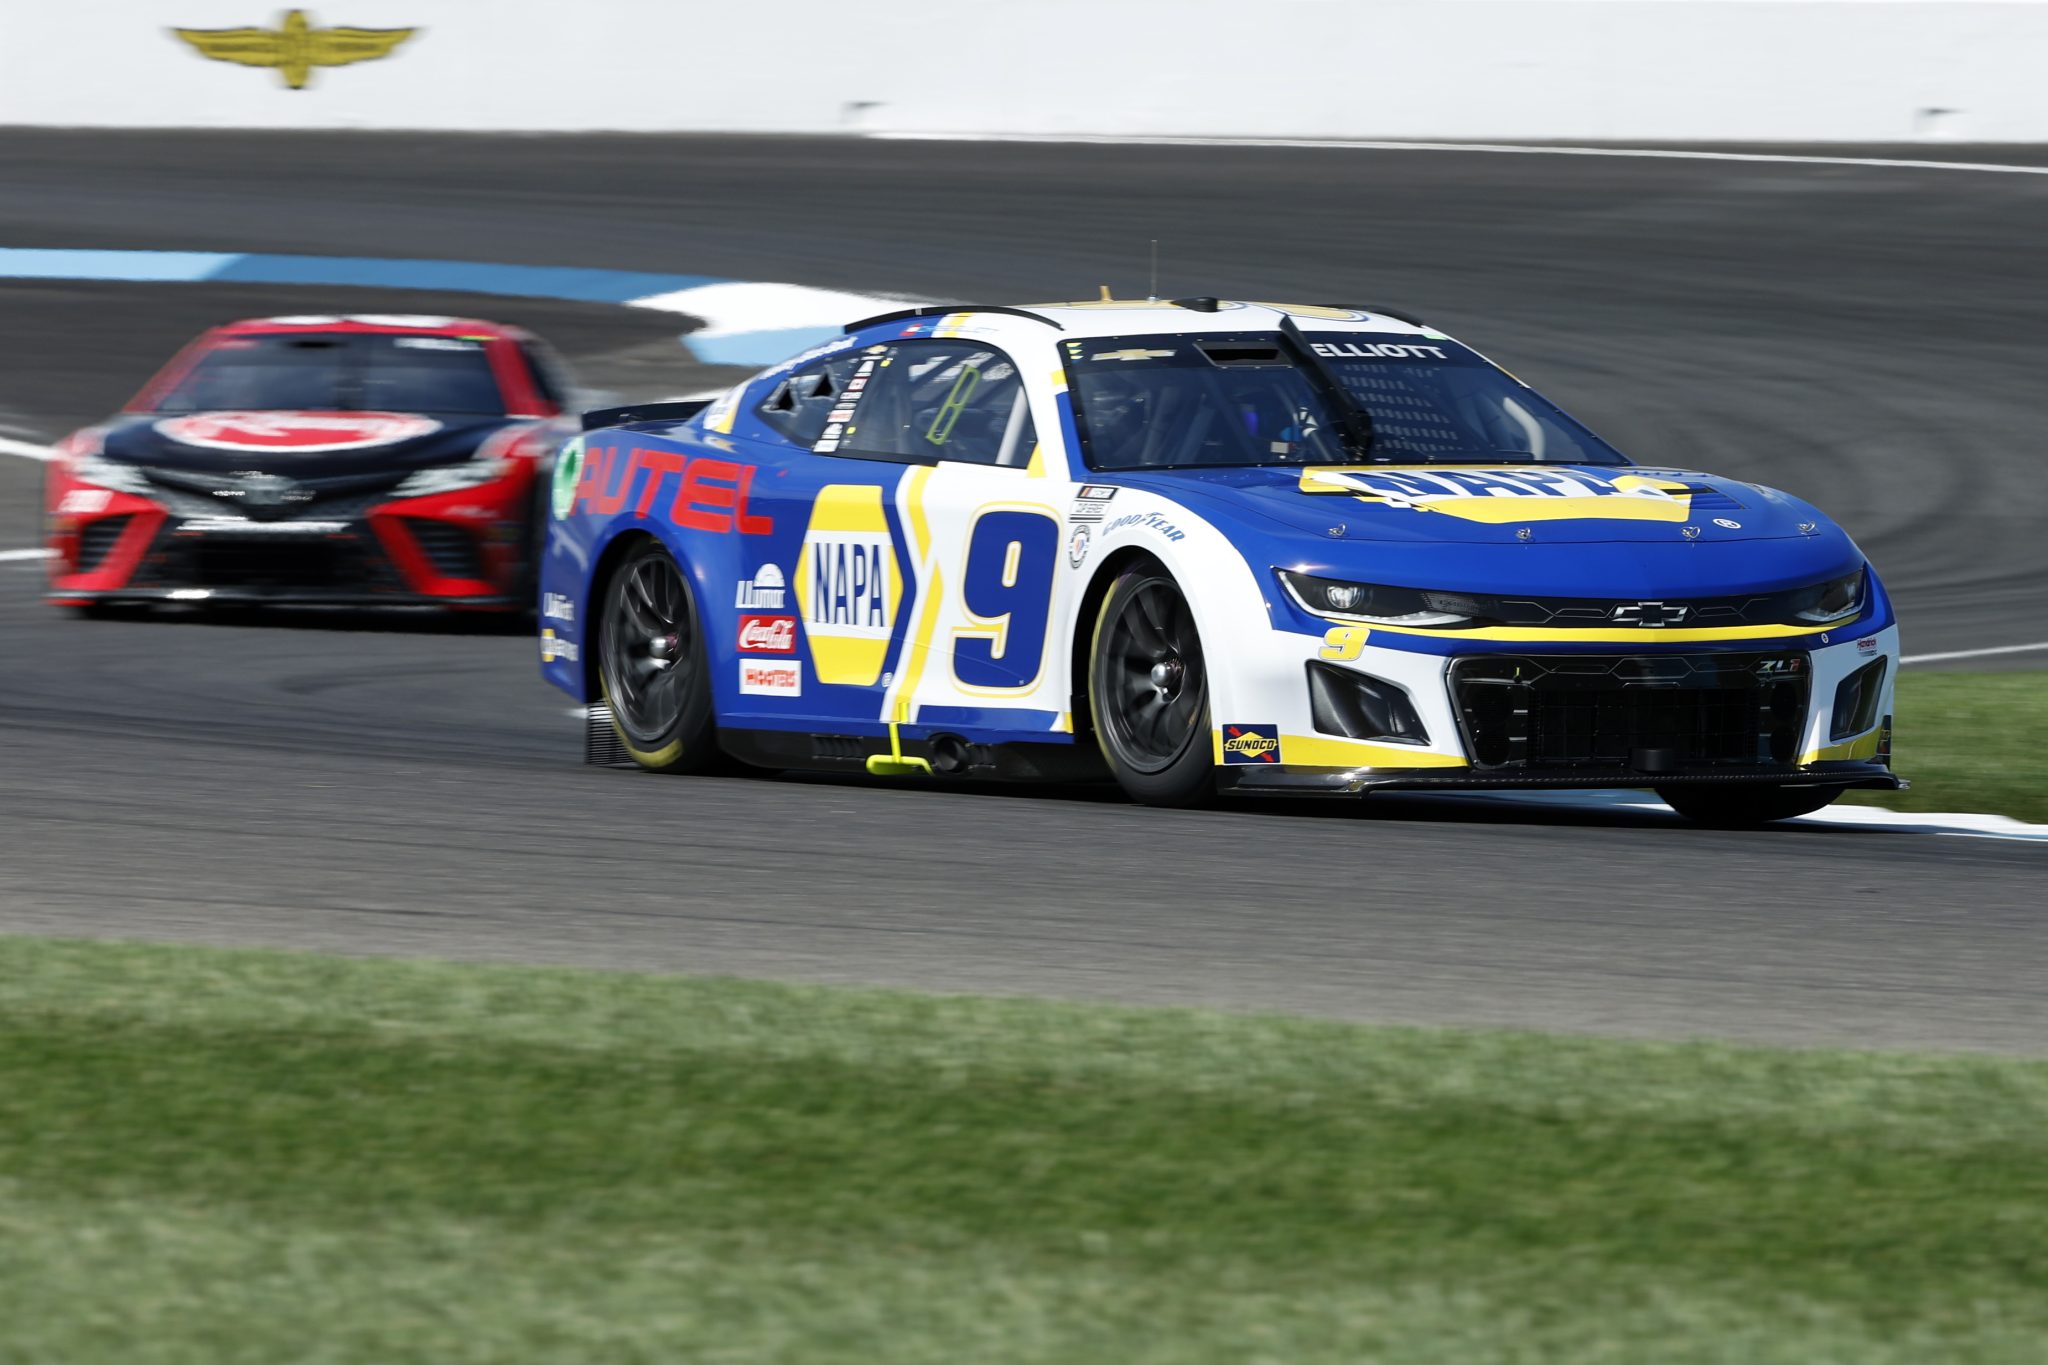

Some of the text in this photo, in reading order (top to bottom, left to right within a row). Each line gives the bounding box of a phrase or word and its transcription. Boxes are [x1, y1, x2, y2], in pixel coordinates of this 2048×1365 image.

[1309, 343, 1448, 359] ELLIOTT
[569, 447, 774, 536] AUTEL
[1343, 470, 1625, 497] NAPA
[815, 542, 883, 627] NAPA
[952, 509, 1060, 688] 9
[1318, 626, 1371, 661] 9
[1227, 739, 1275, 750] SUNOCO
